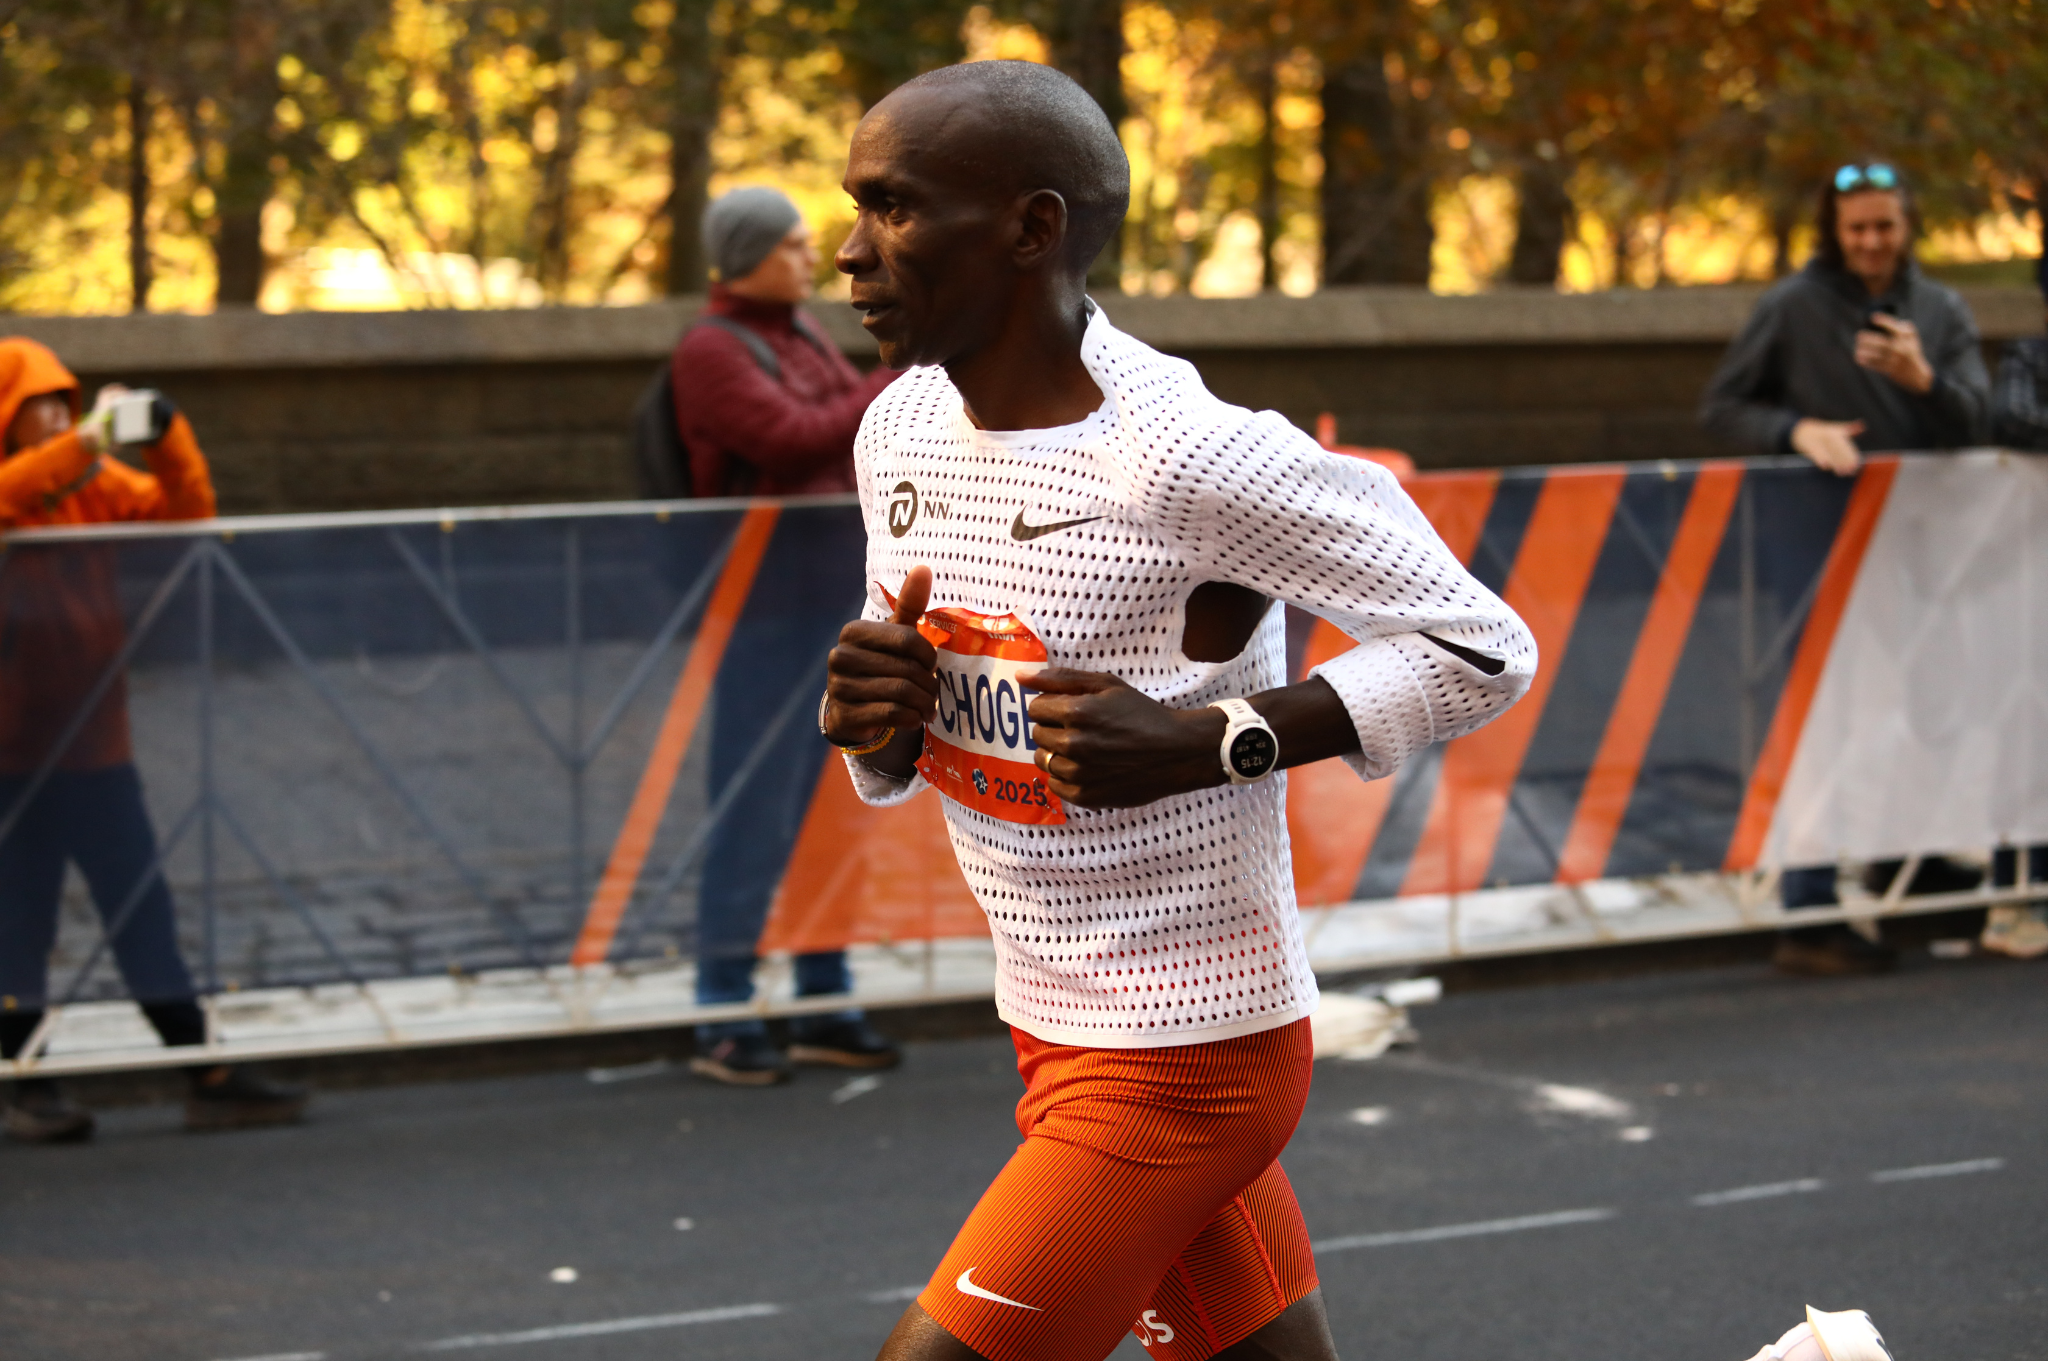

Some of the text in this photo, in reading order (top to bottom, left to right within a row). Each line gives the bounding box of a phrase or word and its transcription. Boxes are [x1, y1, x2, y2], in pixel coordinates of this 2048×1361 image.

[923, 500, 951, 520] NN
[928, 617, 958, 634] SERVICES
[994, 777, 1048, 807] 2025
